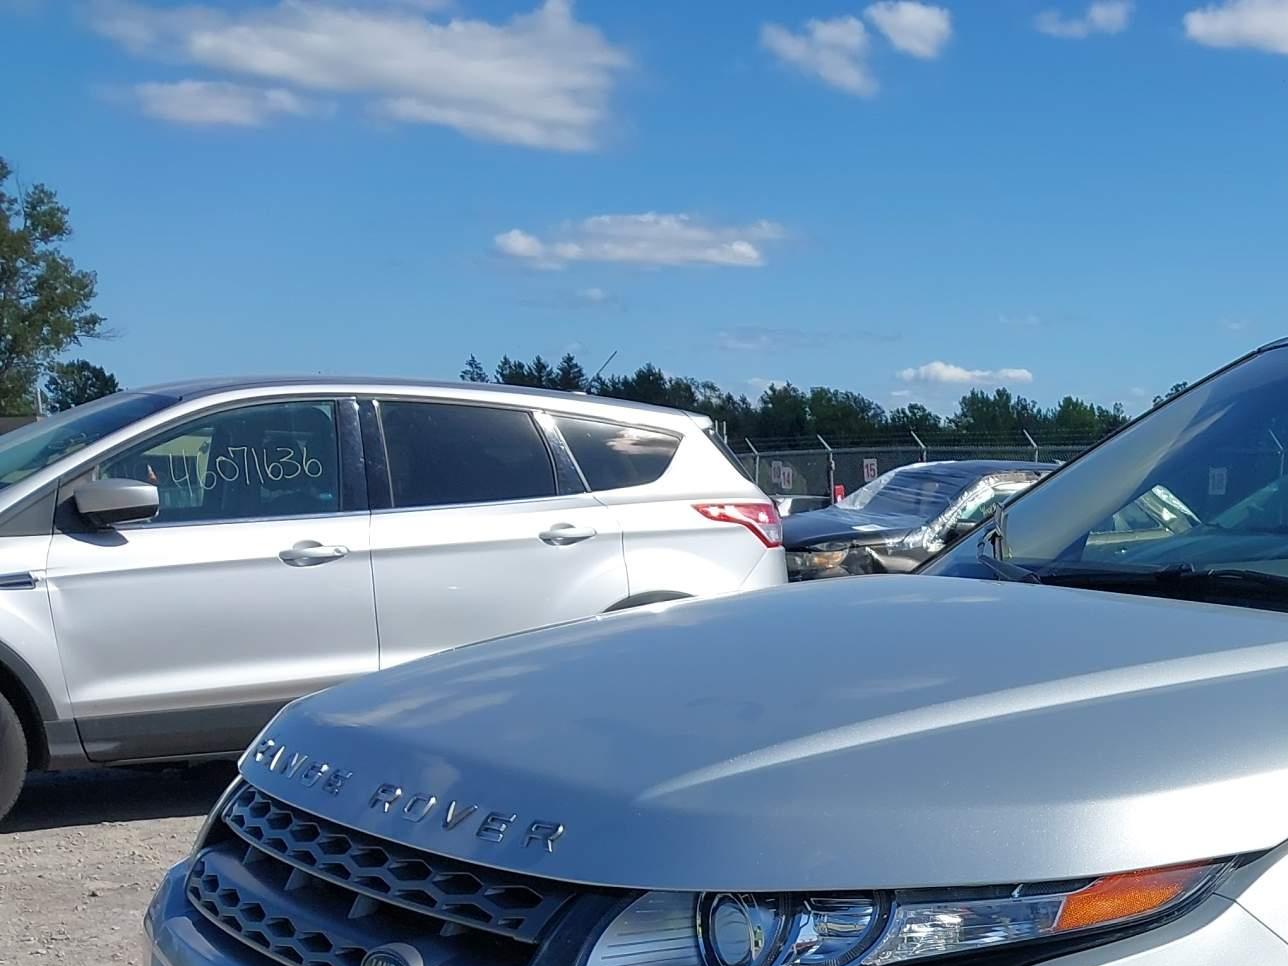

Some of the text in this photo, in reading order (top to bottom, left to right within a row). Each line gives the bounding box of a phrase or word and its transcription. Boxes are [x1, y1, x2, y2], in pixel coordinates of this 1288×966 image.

[169, 447, 323, 497] 46071636
[253, 738, 564, 853] RANGE ROVER
